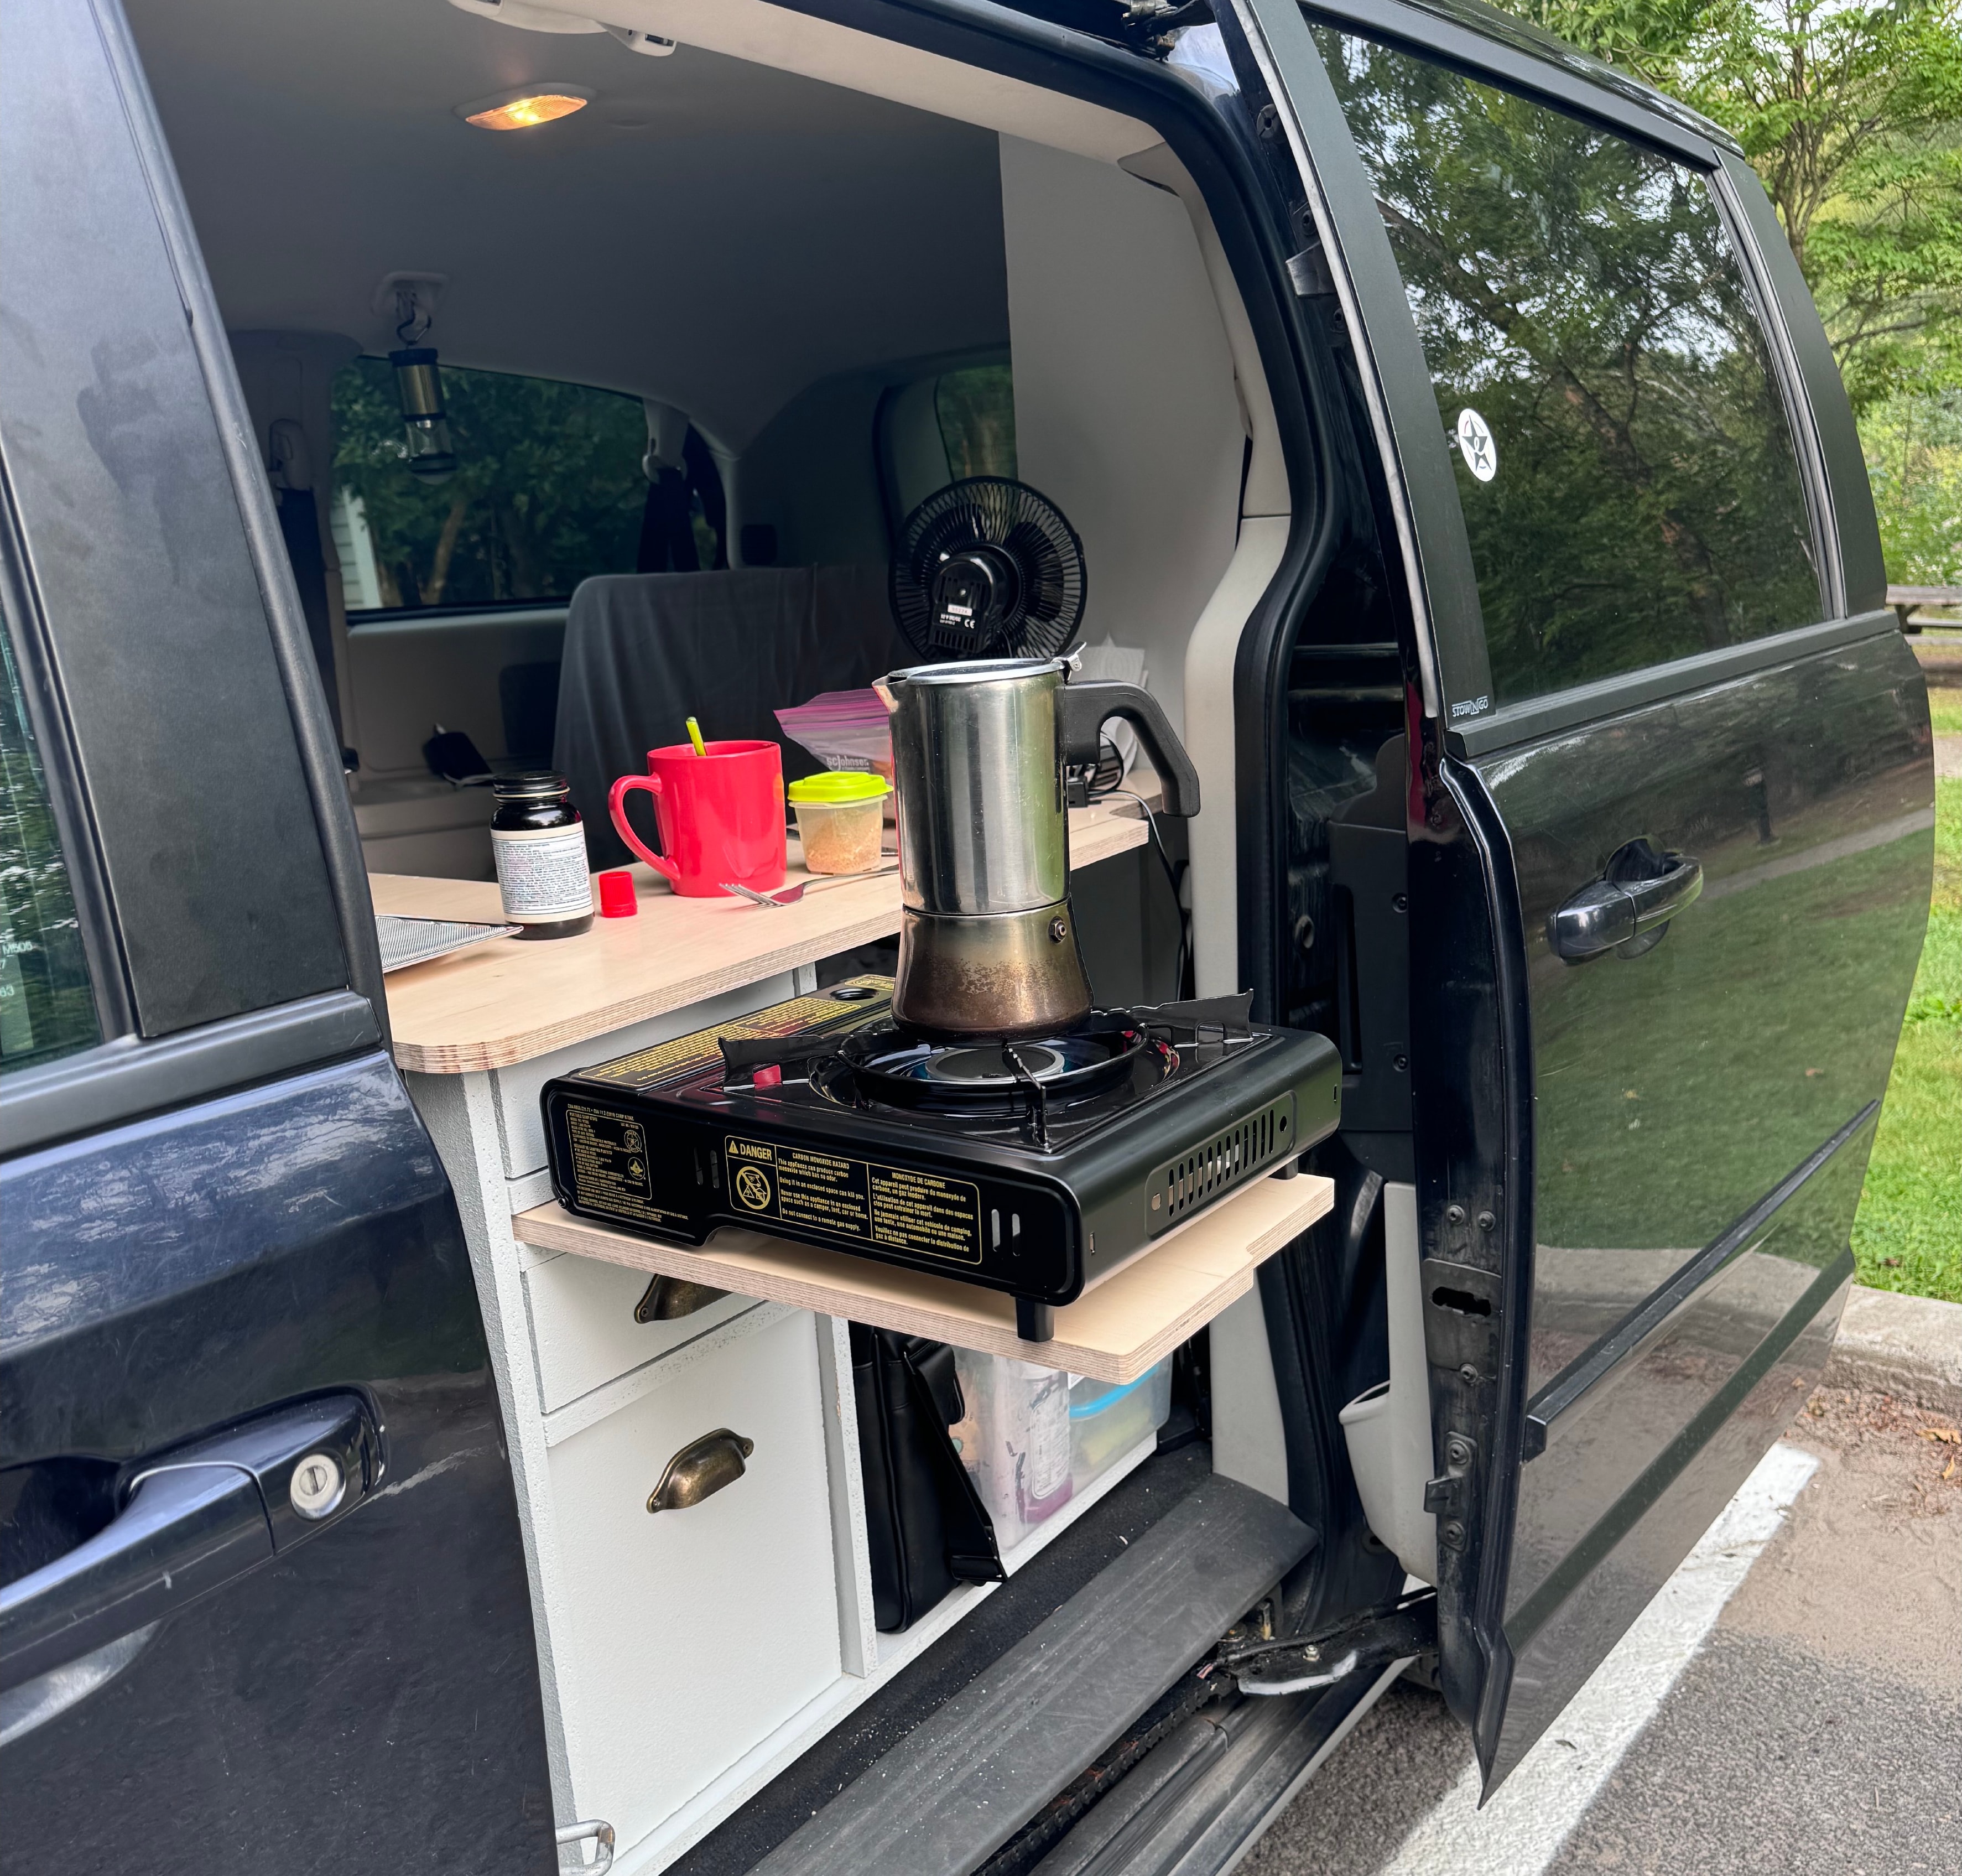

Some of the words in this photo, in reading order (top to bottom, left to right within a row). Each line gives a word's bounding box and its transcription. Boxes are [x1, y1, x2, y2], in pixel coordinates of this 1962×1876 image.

[740, 1143, 772, 1161] DANGER
[793, 1152, 809, 1161] CARBON
[892, 1172, 916, 1183] MONOXYDE
[924, 1179, 945, 1188] CARBONE
[914, 1203, 932, 1211] appareil
